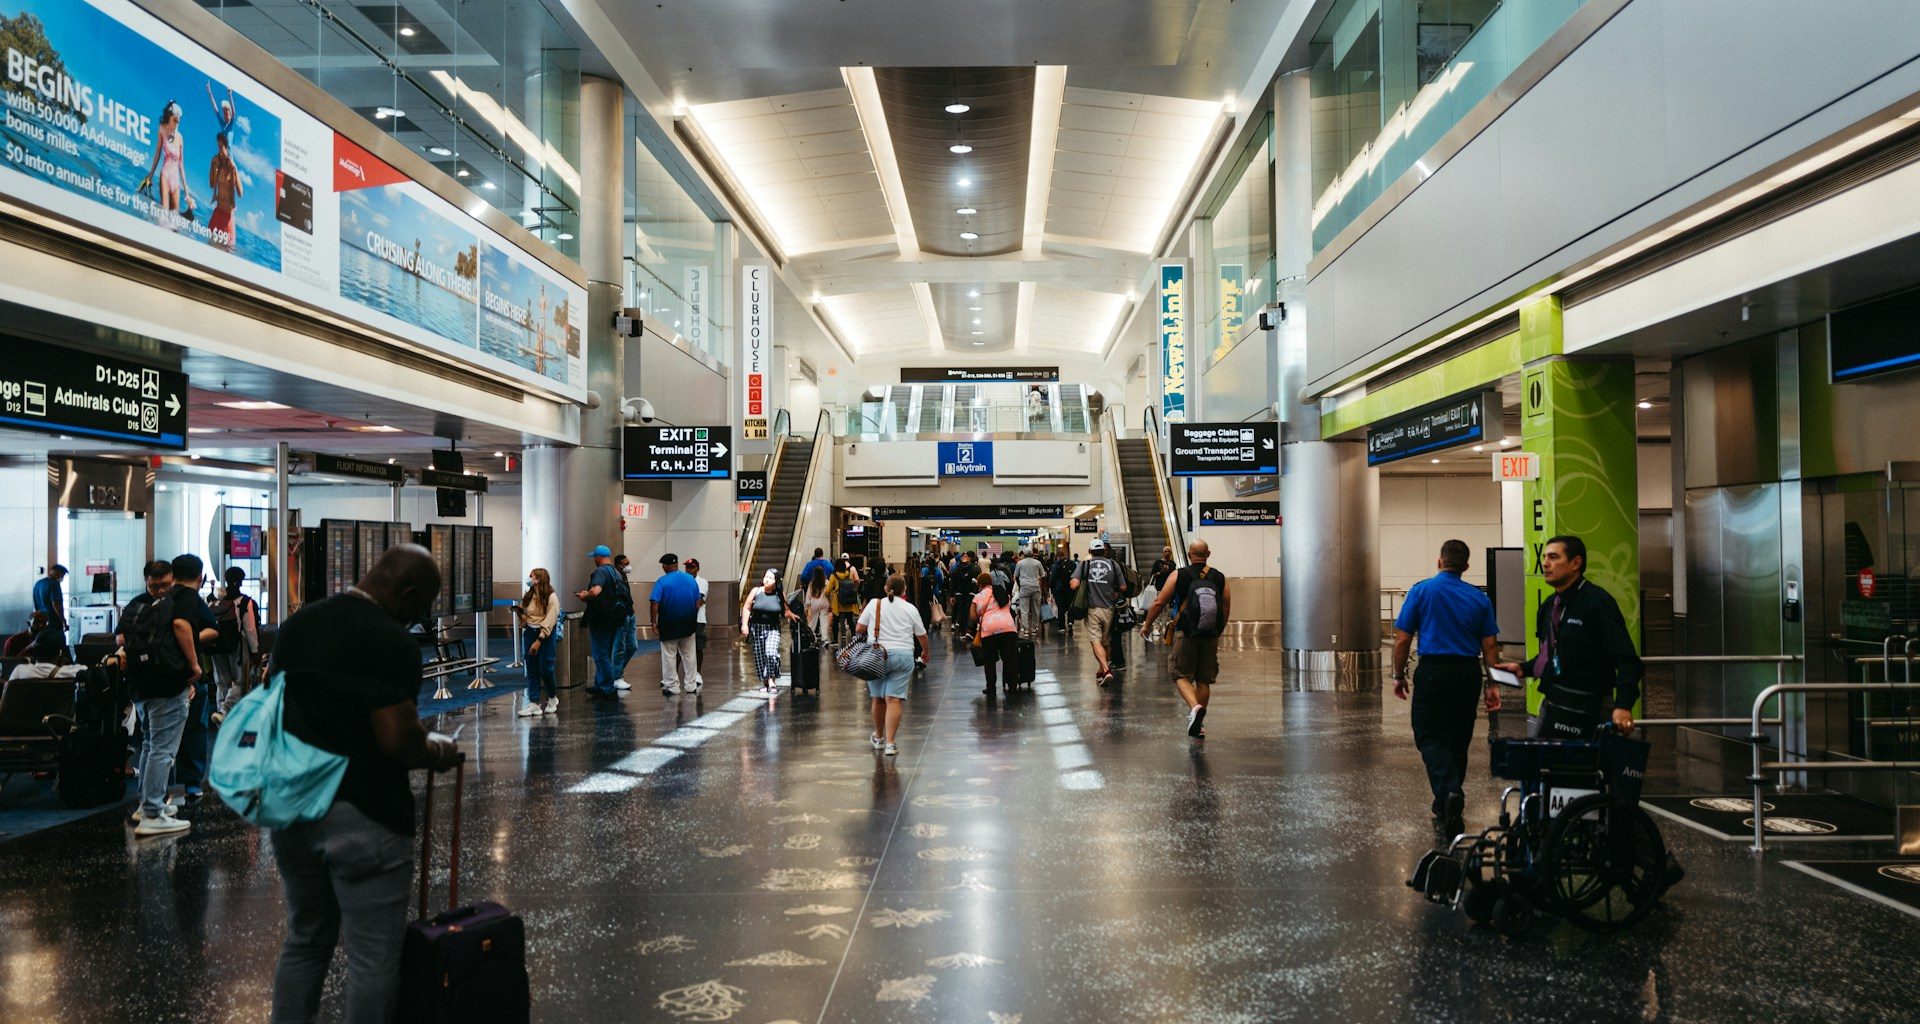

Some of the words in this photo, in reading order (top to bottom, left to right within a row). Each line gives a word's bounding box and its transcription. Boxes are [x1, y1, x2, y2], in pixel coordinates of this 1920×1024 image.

[8, 47, 93, 117] BEGINS
[98, 93, 151, 146] HERE
[6, 91, 35, 115] with
[37, 102, 79, 135] 50,000
[6, 109, 45, 145] bonus
[46, 131, 80, 158] miles.
[6, 142, 24, 163] $0
[25, 149, 55, 176] intro
[56, 165, 95, 191] annual
[96, 178, 114, 200] fee
[116, 187, 132, 205] for
[133, 197, 149, 214] the
[150, 203, 169, 220] first
[170, 213, 191, 232] year,
[192, 219, 212, 239] then
[367, 231, 415, 271] CRUISING
[415, 252, 446, 285] ALONG
[486, 290, 510, 317] BEGINS
[510, 303, 527, 326] HERE
[751, 269, 760, 373] CLUBHOUSE
[1162, 279, 1184, 395] NewsLink
[96, 365, 139, 389] D1-D25
[54, 387, 110, 412] Admirals
[112, 397, 139, 417] Club
[749, 376, 761, 413] one
[6, 401, 21, 413] D12
[128, 420, 139, 430] D15
[745, 419, 767, 427] KITCHEN
[659, 429, 693, 441] EXIT
[745, 429, 749, 438] &
[755, 429, 767, 438] BAR
[1184, 429, 1216, 439] Baggage
[1217, 428, 1239, 437] Claim
[649, 445, 693, 455] Terminal
[962, 449, 971, 461] 2
[1175, 447, 1203, 456] Ground
[1203, 447, 1239, 456] Transport
[336, 460, 355, 472] FLIGHT
[355, 463, 387, 476] INFORMATION
[651, 461, 659, 471] F,
[661, 461, 672, 471] G,
[674, 461, 685, 471] H,
[687, 461, 693, 470] J
[956, 463, 987, 473] skytrain
[1502, 457, 1529, 477] EXIT
[740, 479, 763, 489] D25
[628, 504, 645, 516] EXIT
[1554, 721, 1582, 736] envoy
[1551, 795, 1565, 811] AA
